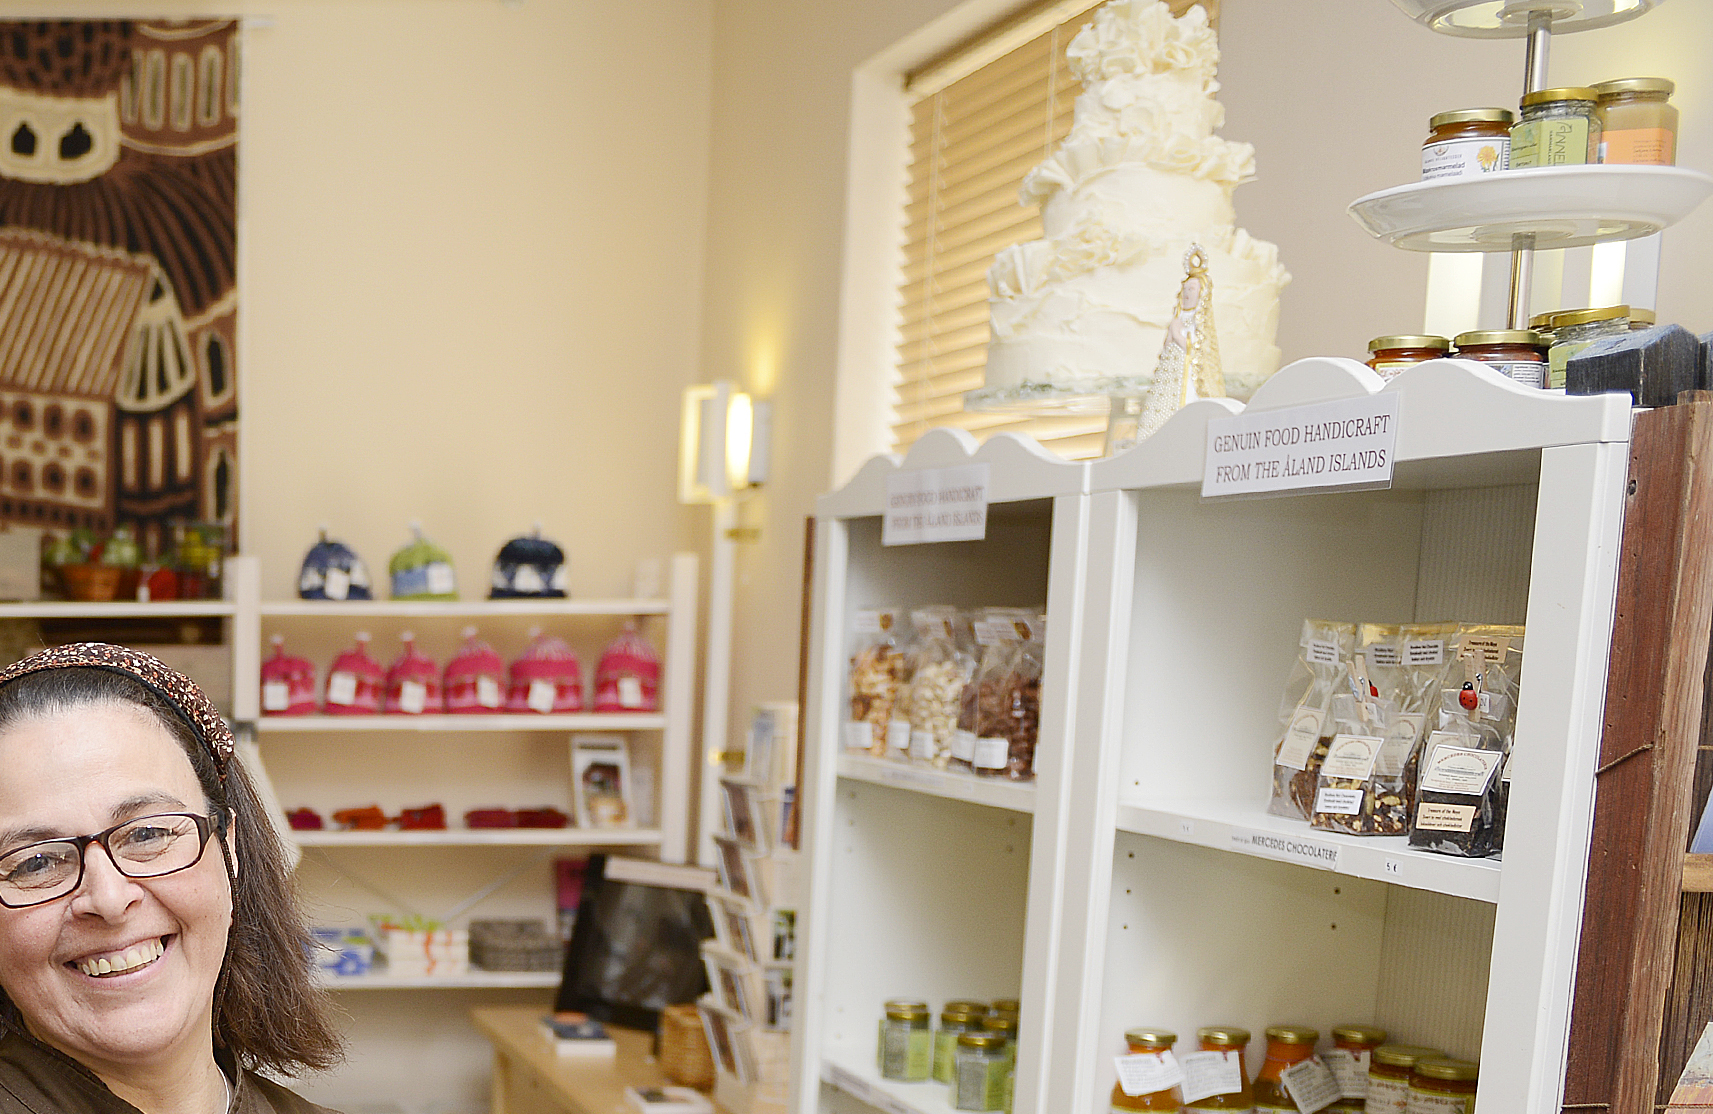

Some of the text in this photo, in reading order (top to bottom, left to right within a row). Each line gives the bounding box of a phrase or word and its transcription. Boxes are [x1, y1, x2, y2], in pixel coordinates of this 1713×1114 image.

[1214, 414, 1390, 453] GENUIN FOOD HANDICRAFT
[1216, 463, 1250, 483] FROM
[1255, 460, 1279, 480] THE
[1328, 449, 1386, 473] ISLANDS
[1252, 835, 1285, 851] MERCEDES
